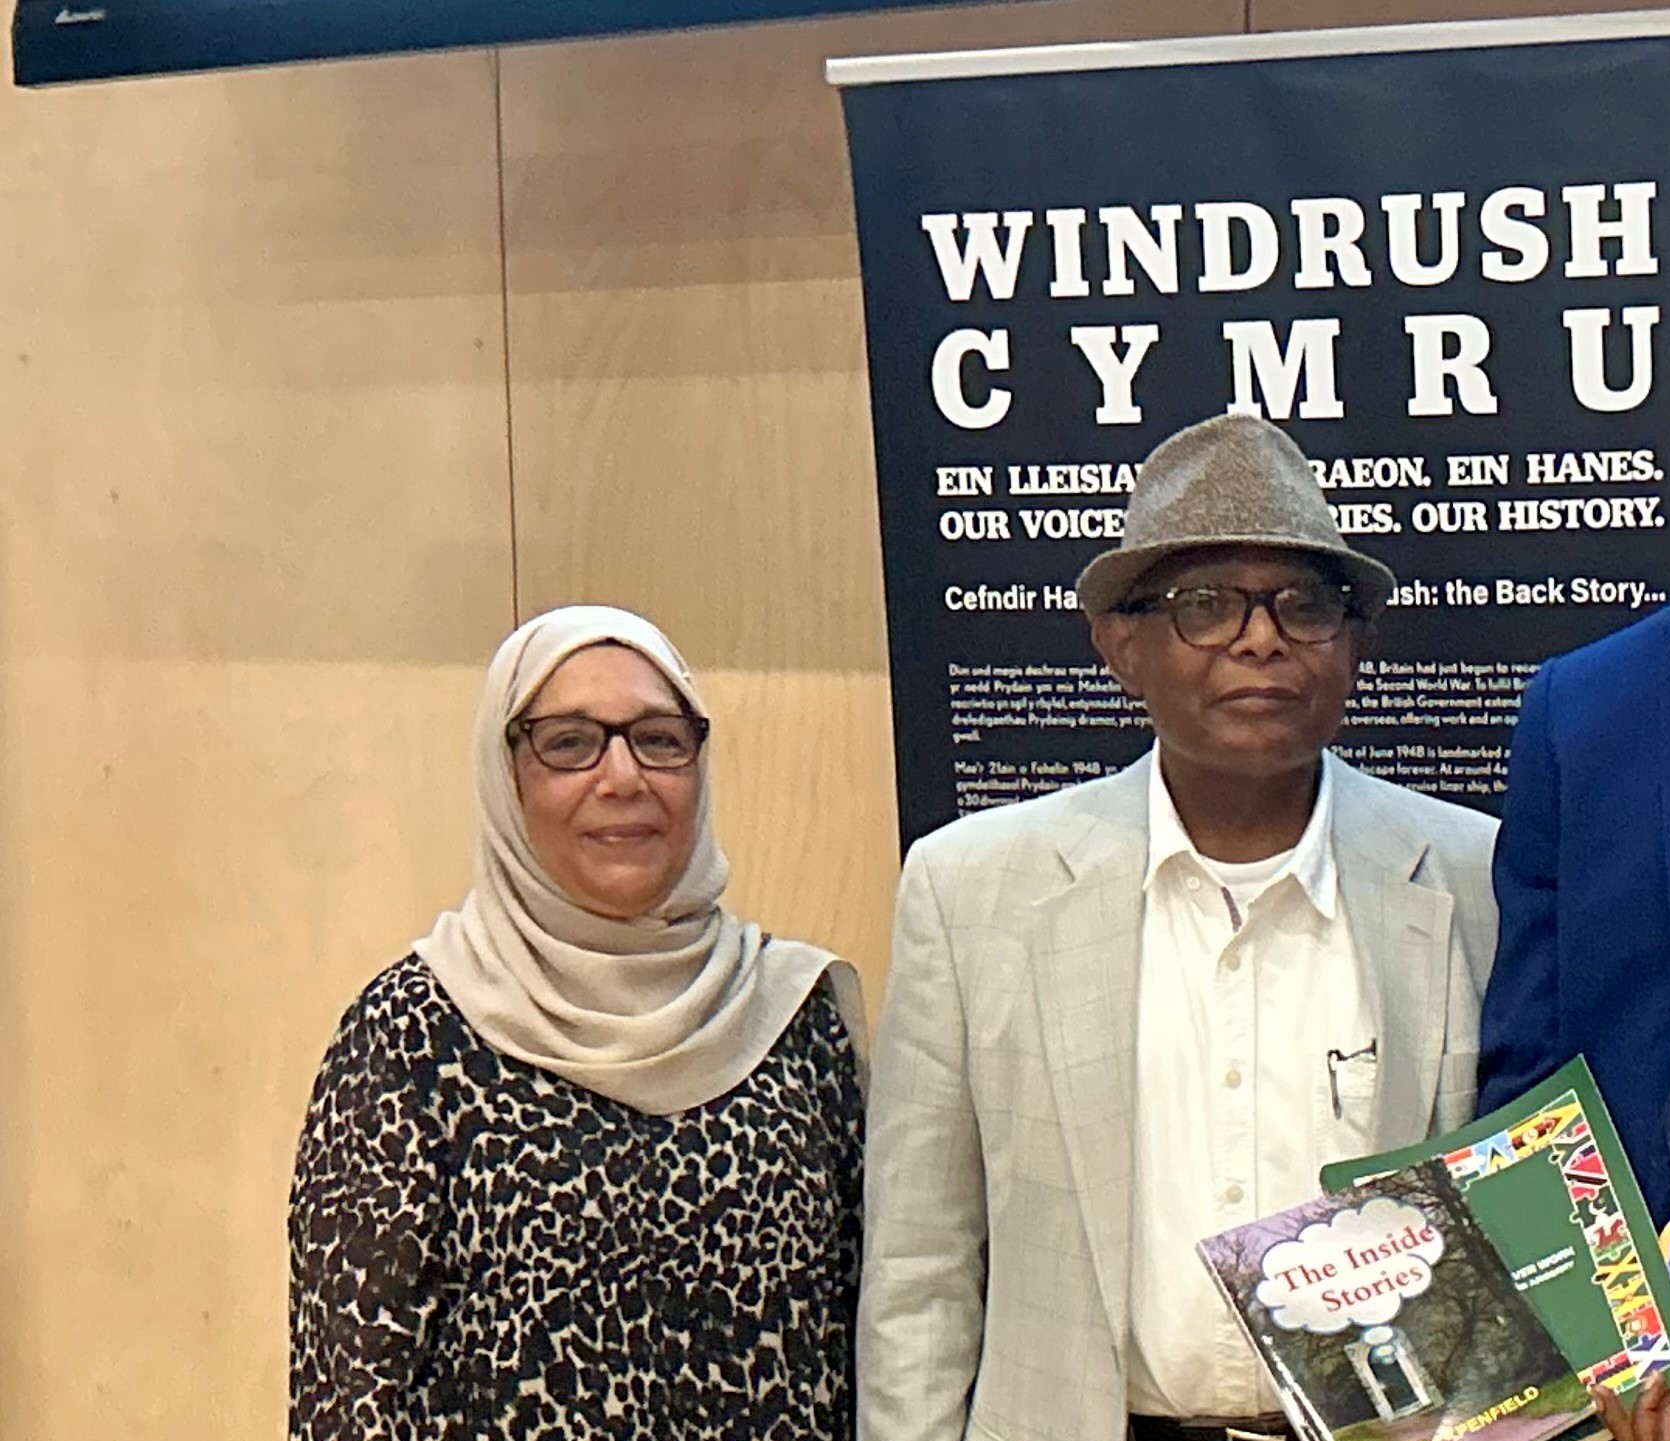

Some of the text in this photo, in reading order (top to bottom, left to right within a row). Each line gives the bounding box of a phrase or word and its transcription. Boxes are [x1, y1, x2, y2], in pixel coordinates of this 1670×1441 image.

[921, 181, 1659, 302] WINDRUSH
[935, 466, 994, 496] EIN
[1008, 463, 1144, 495] LLEISIA
[1447, 455, 1509, 487] EIN
[1526, 450, 1664, 484] HANES.
[939, 510, 1012, 540] OUR
[1018, 508, 1130, 539] VOICE
[1412, 501, 1488, 532] OUR
[1498, 496, 1666, 531] HISTORY.
[944, 584, 1037, 611] Cefndir
[1043, 585, 1084, 611] Ha
[1446, 581, 1489, 605] the
[1496, 579, 1564, 604] Back
[1570, 576, 1667, 609] Story...
[1274, 1226, 1435, 1292] The Inside
[1321, 1265, 1424, 1312] Stories
